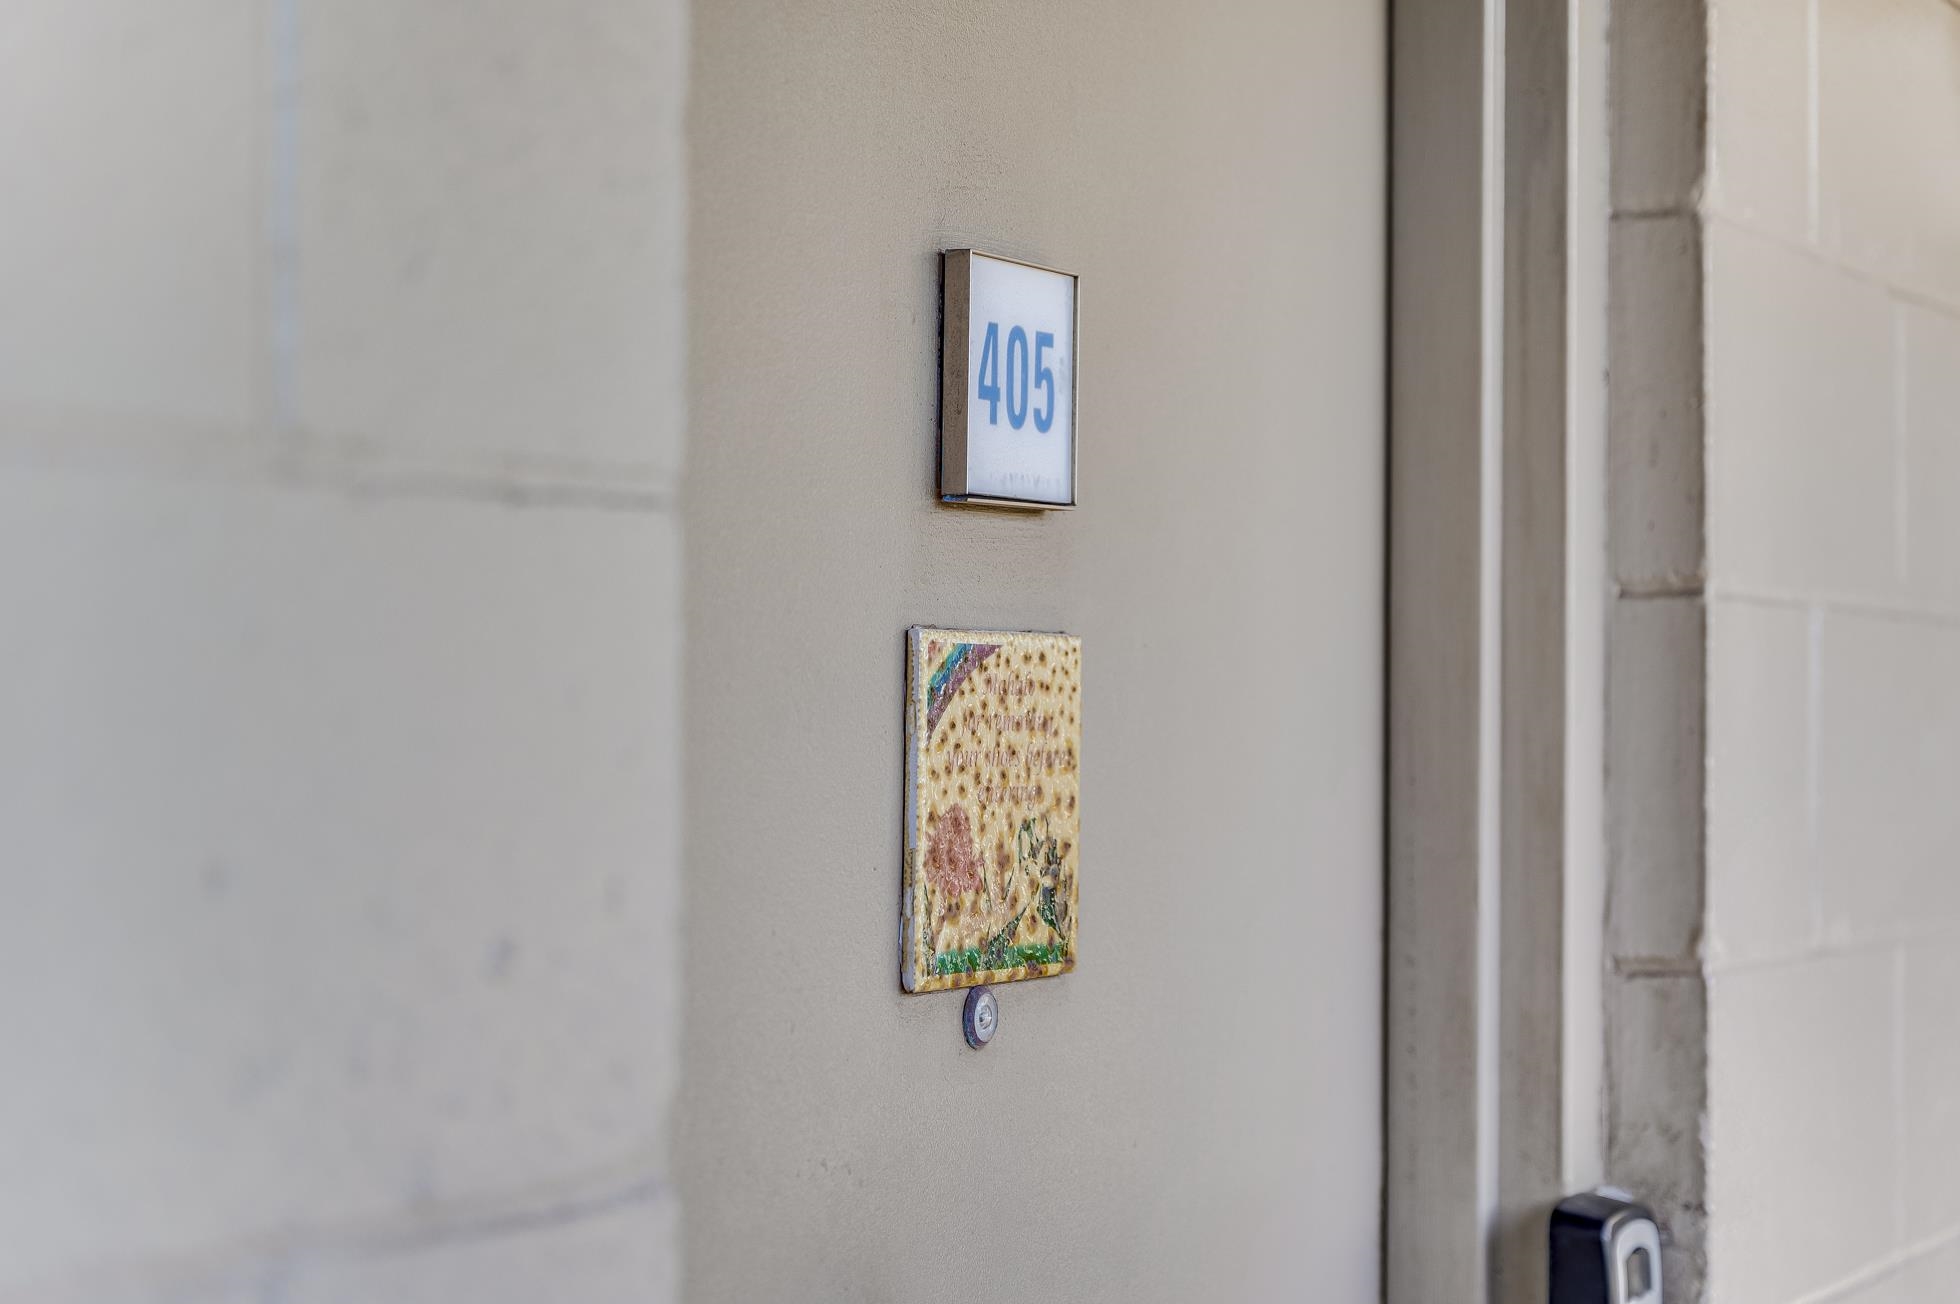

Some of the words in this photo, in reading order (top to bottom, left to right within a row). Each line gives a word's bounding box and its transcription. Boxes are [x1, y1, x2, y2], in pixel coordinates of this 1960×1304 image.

[977, 321, 1055, 434] 405
[947, 748, 982, 775] your
[985, 744, 1021, 768] shoes
[978, 785, 1038, 811] entering
